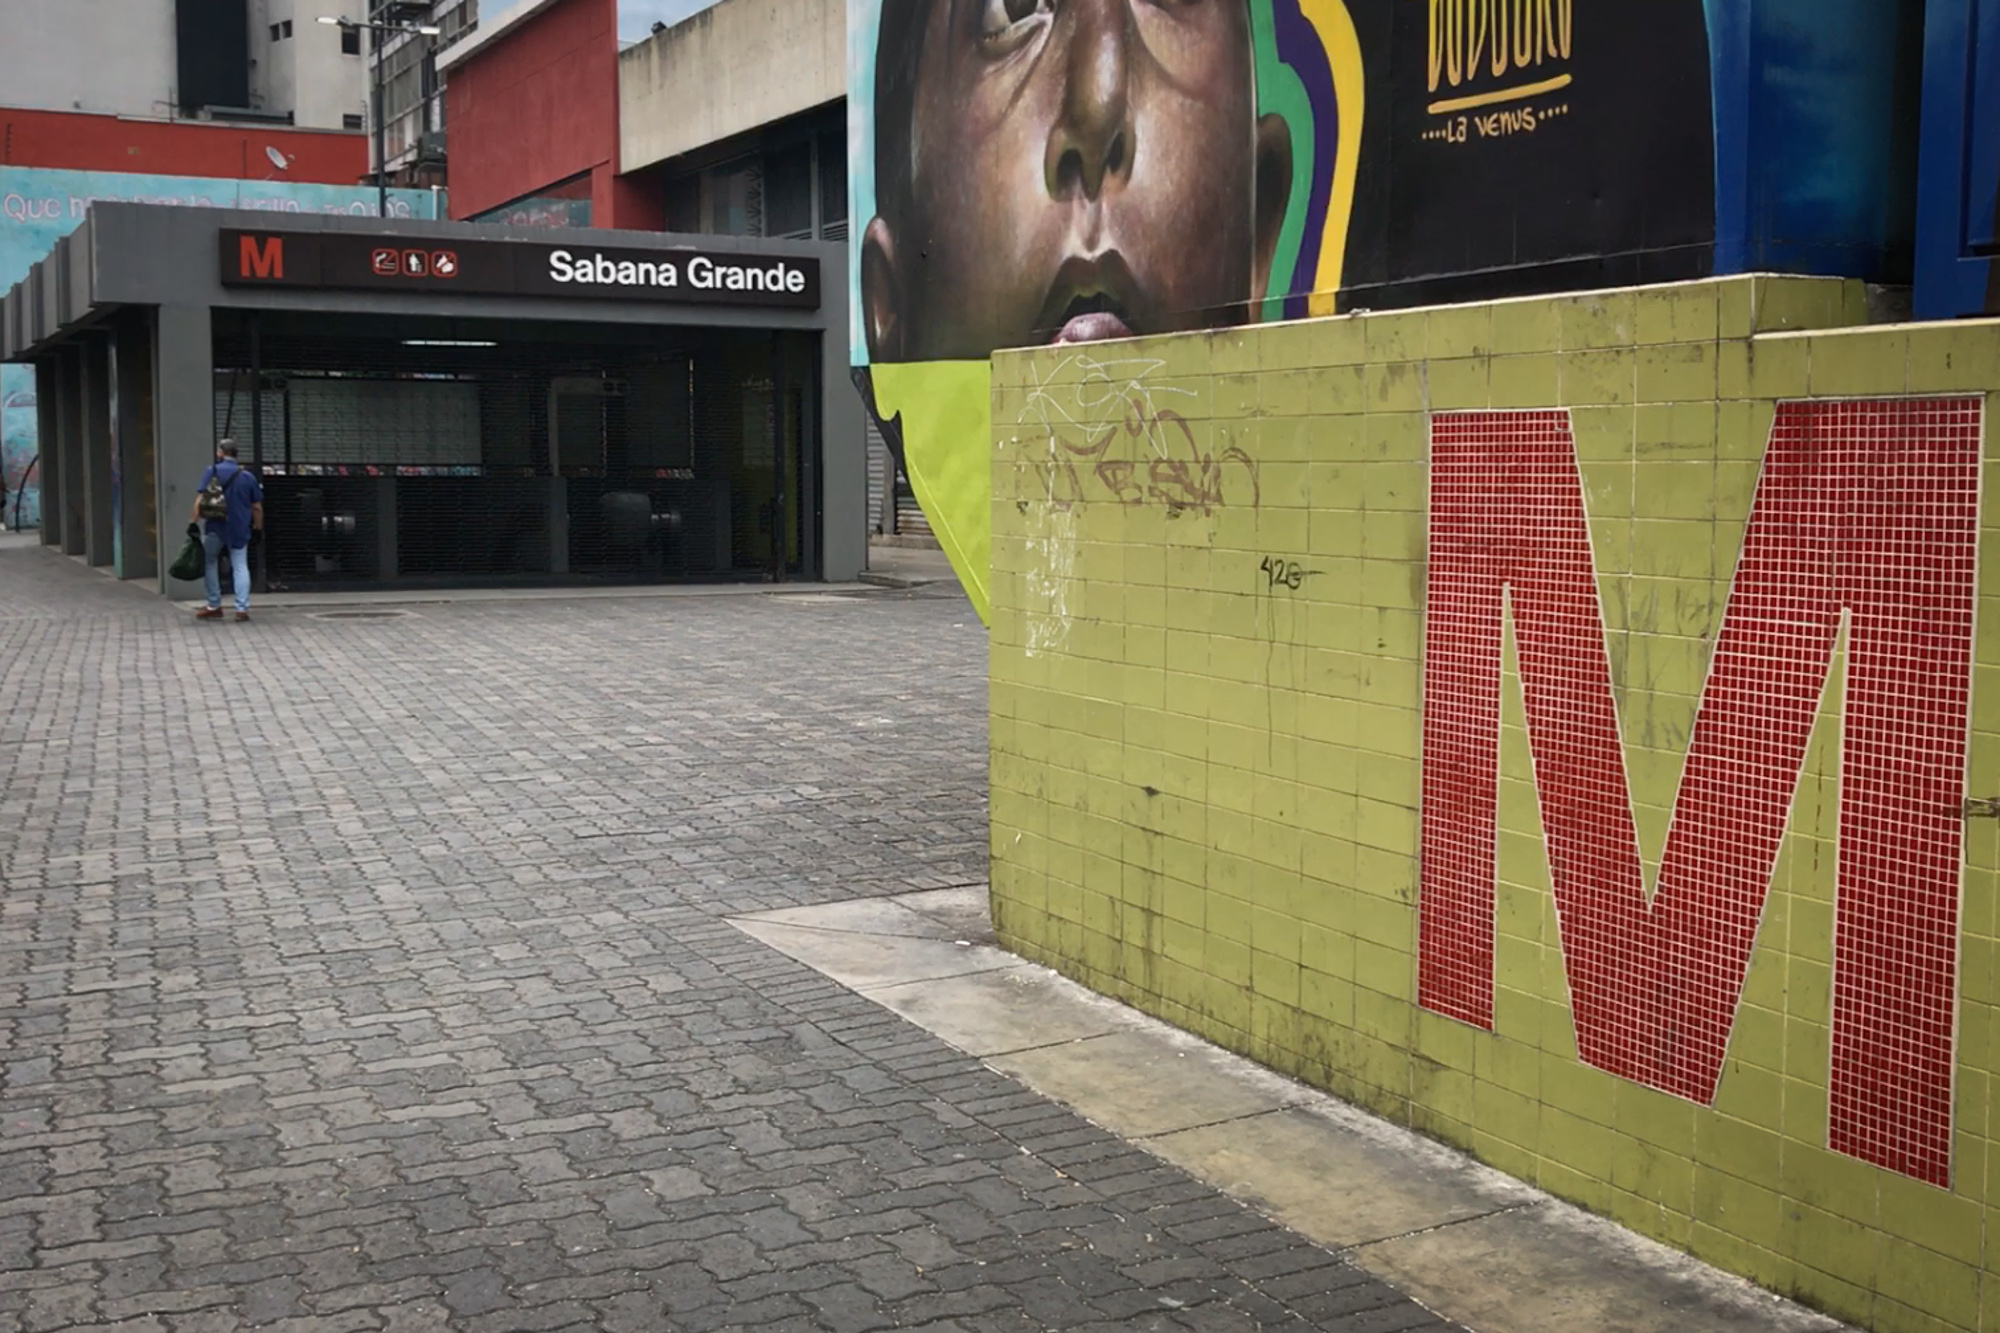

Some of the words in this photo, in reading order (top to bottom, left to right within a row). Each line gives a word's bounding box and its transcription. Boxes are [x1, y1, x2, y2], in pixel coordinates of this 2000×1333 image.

[239, 235, 284, 279] M
[549, 250, 678, 287] Sabana
[687, 256, 806, 293] Grande
[1418, 393, 1985, 1191] M
